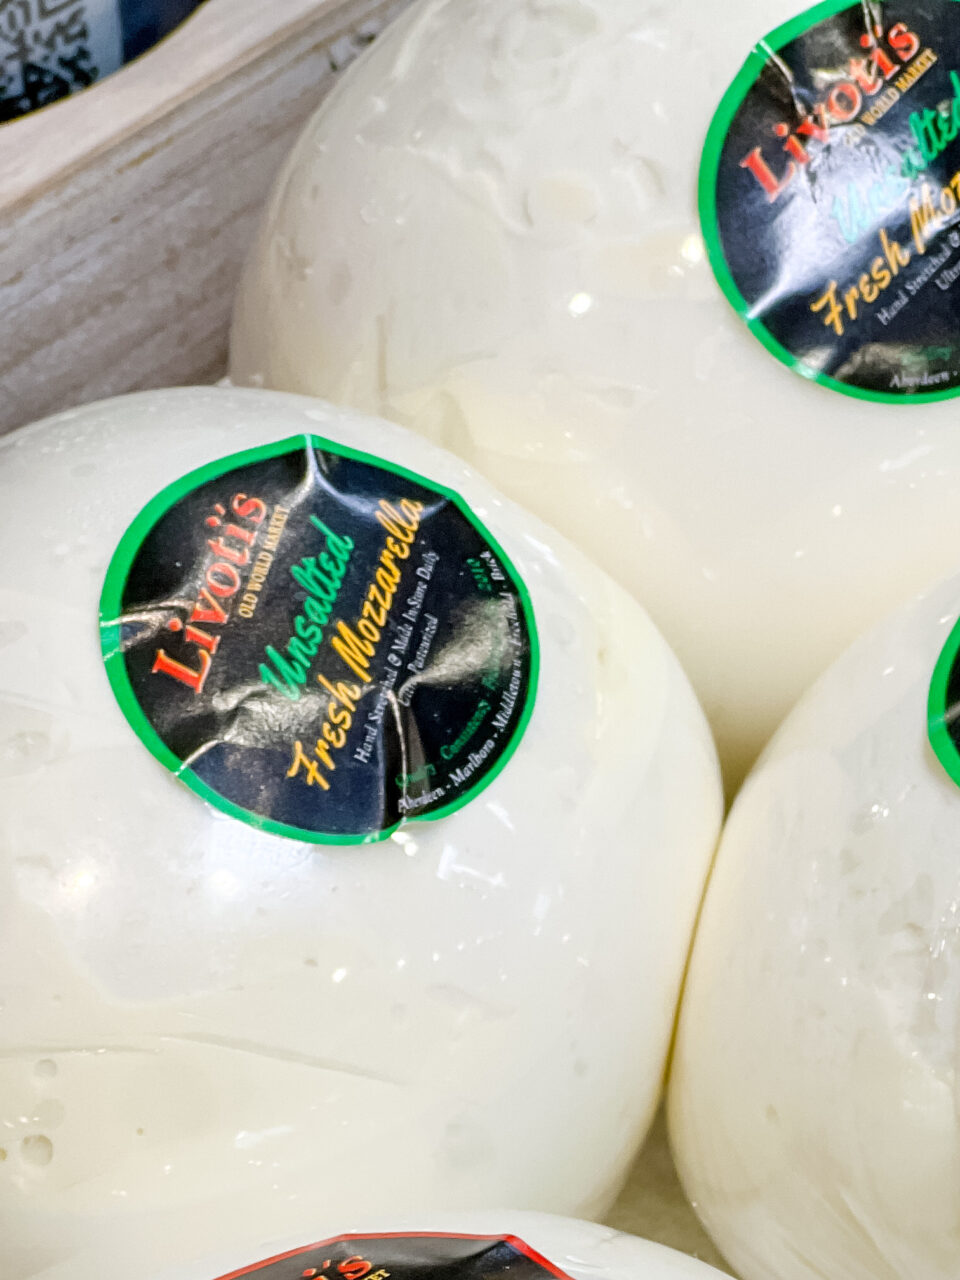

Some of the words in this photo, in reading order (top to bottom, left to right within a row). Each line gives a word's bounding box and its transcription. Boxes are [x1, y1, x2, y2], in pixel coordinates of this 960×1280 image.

[861, 86, 899, 125] WORLD
[895, 48, 938, 93] MARKET
[810, 228, 909, 336] Fresh
[152, 493, 266, 693] Livoti's
[238, 593, 258, 618] OLD
[248, 551, 273, 591] WORLD
[262, 504, 291, 551] MARKET
[258, 513, 354, 700] Unsalted
[285, 674, 361, 790] Fresh
[331, 498, 424, 683] Mozzarella
[353, 723, 378, 763] Hand
[391, 623, 414, 654] Made
[416, 550, 440, 581] Daily
[449, 738, 496, 788] Marlboro
[491, 660, 522, 733] Middletown
